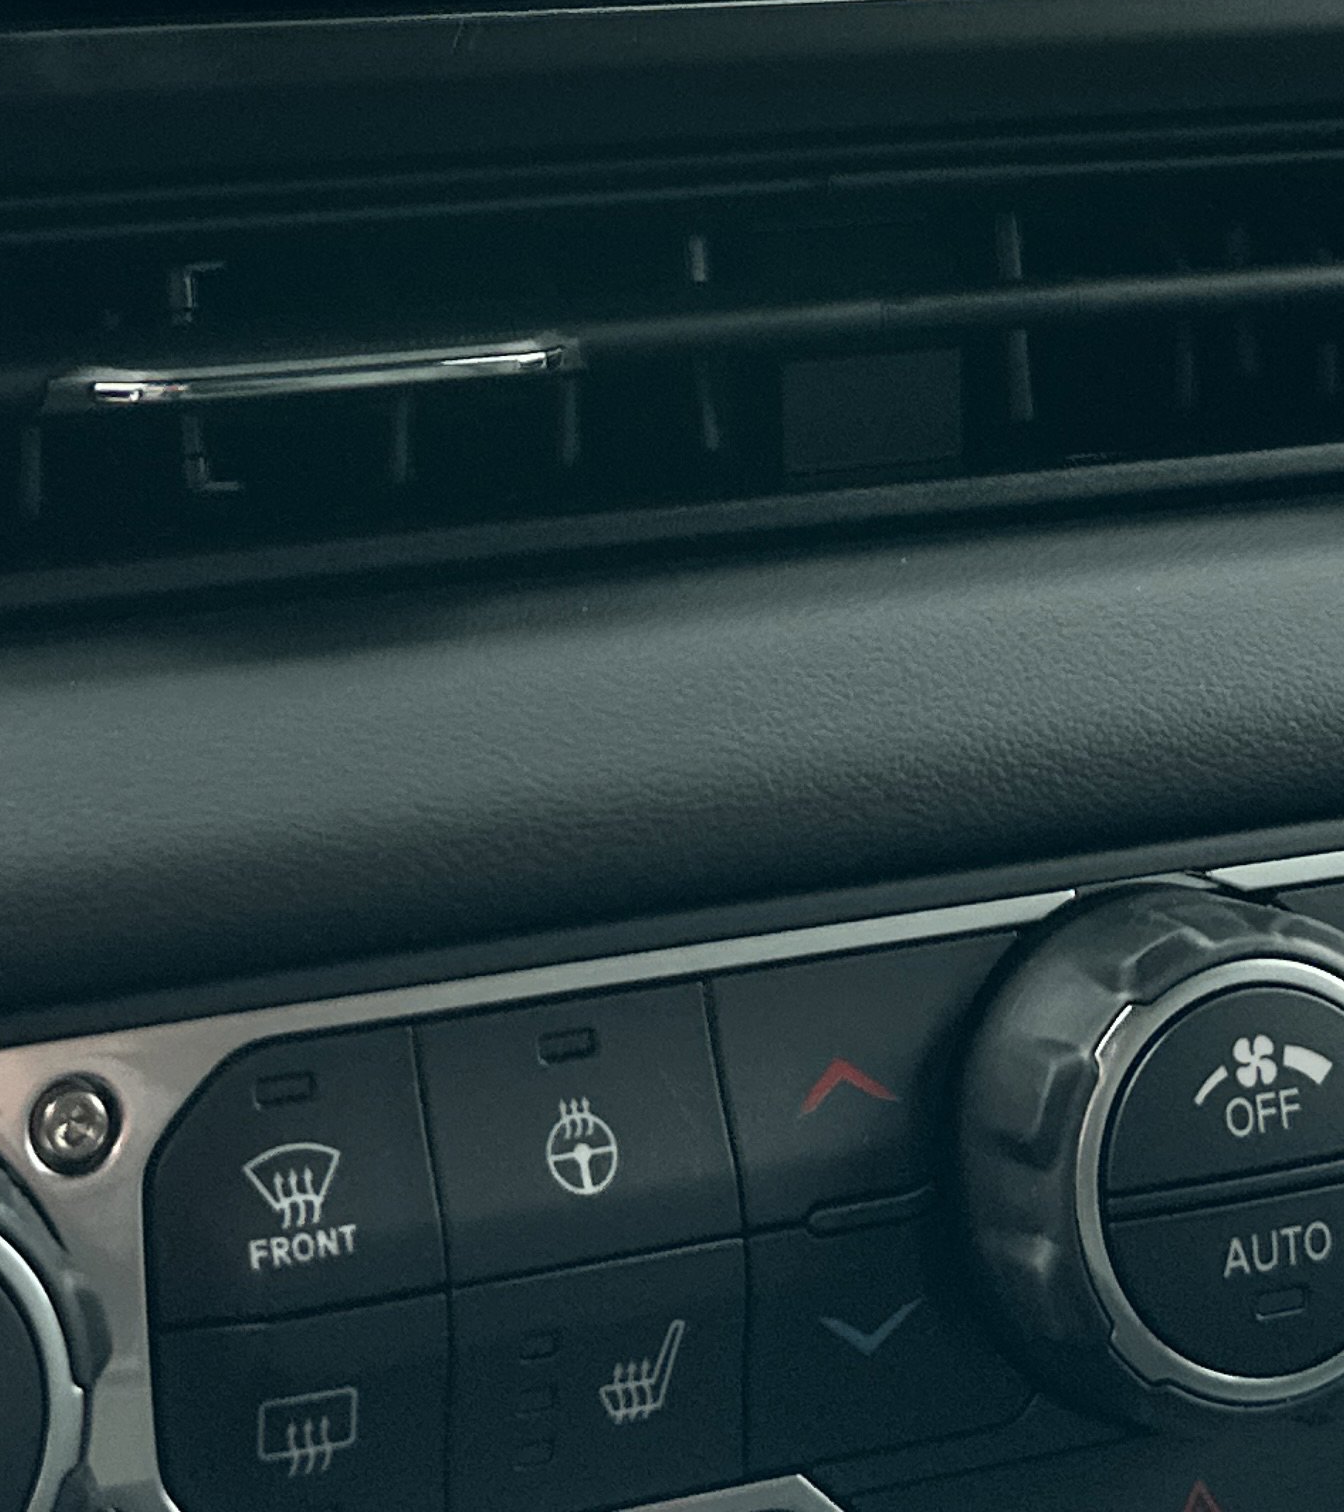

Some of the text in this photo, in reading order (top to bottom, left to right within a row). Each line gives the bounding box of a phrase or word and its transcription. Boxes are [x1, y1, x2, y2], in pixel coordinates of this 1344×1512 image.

[1224, 1092, 1302, 1139] OFF
[248, 1224, 359, 1270] FRONT
[1222, 1220, 1334, 1279] AUTO
